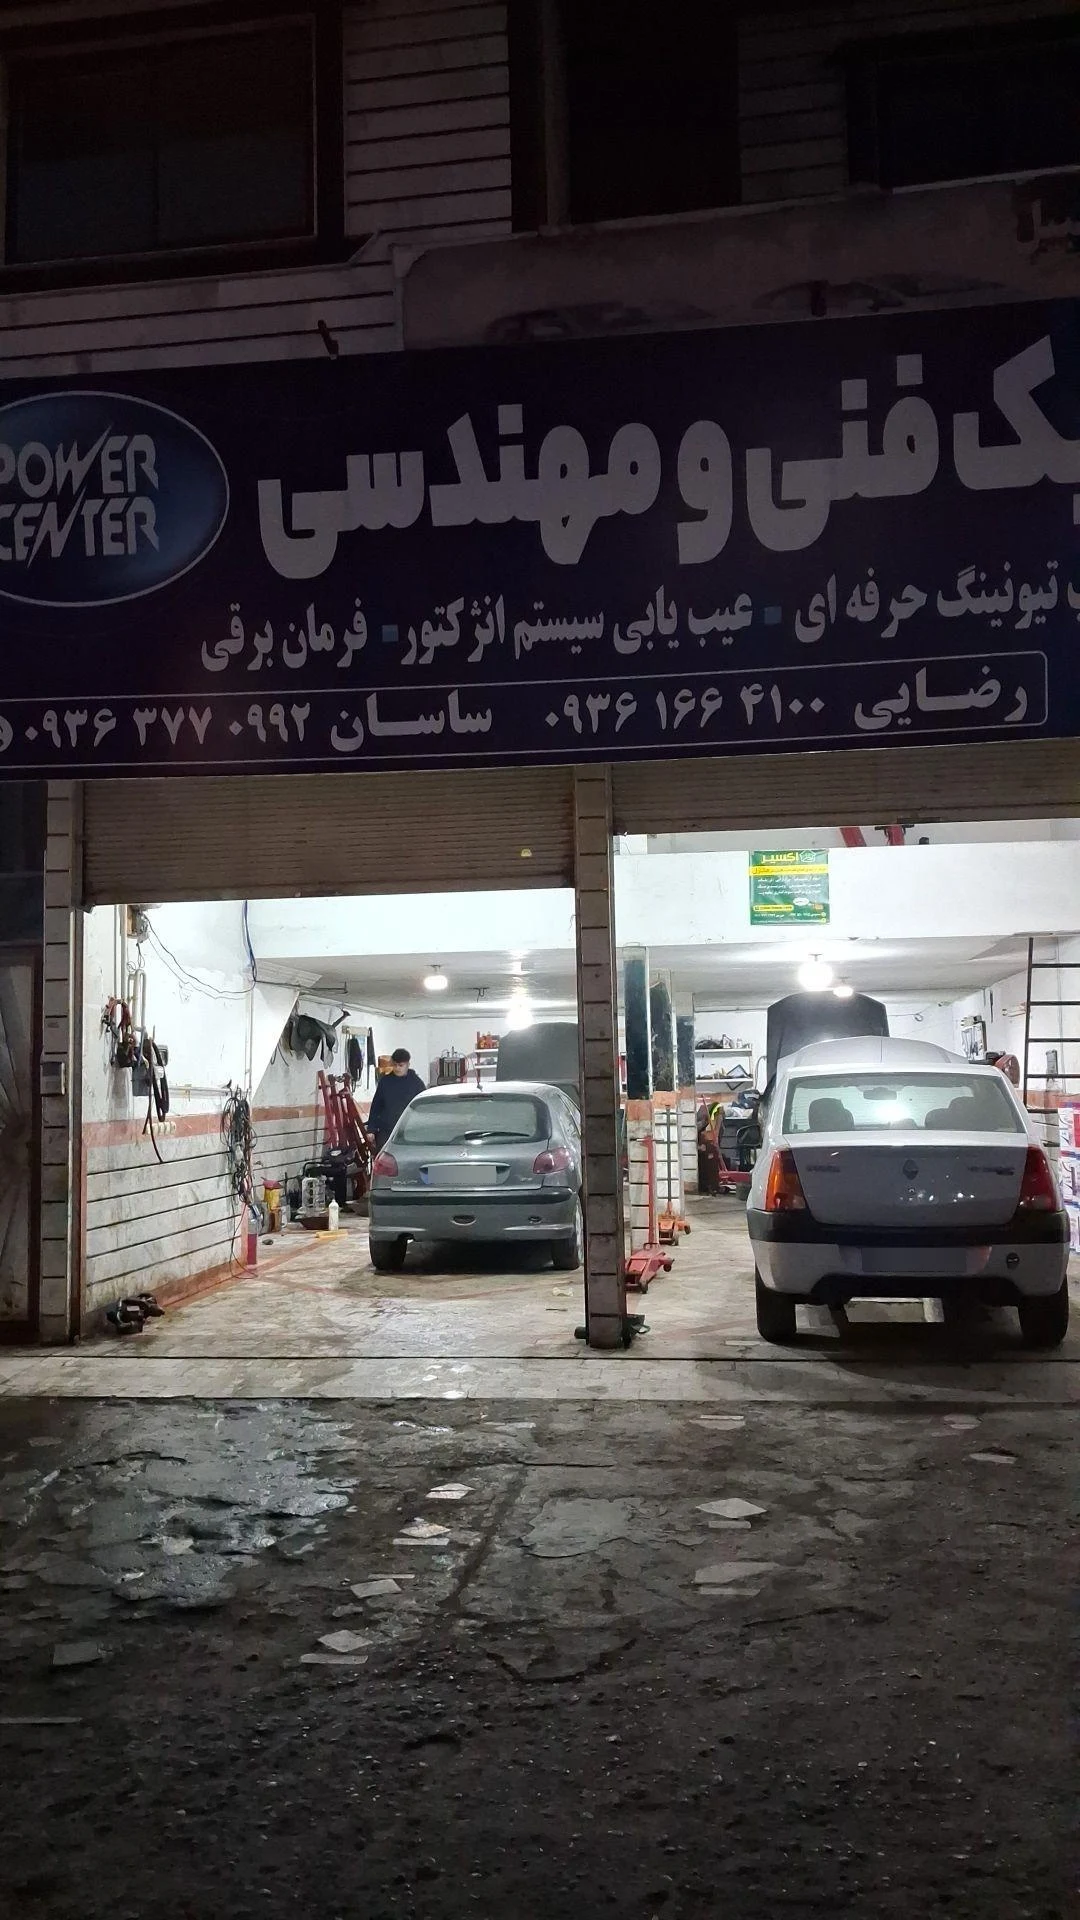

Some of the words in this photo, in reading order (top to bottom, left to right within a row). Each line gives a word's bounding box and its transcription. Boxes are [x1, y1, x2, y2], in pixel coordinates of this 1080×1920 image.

[746, 354, 940, 553] فنی
[257, 404, 661, 581] مهندسی
[677, 420, 734, 565] و
[613, 585, 678, 654] یابی
[688, 593, 753, 646] عیب
[795, 573, 837, 643] ای
[846, 567, 927, 639] حرفه
[937, 561, 1059, 630] تیونینگ
[201, 602, 274, 673] برقی
[283, 598, 368, 669] فرمان
[514, 600, 604, 660] سیستم
[25, 707, 117, 749] ۰۹۳۶
[133, 707, 212, 745] ۳۷۷
[229, 703, 311, 745] ۰۹۹۲
[331, 690, 493, 753] ساسان
[545, 691, 638, 735] ۰۹۳۶
[655, 687, 723, 730] ۱۶۶
[740, 683, 826, 726] ۴۱۰۰
[854, 665, 1028, 731] رضایی
